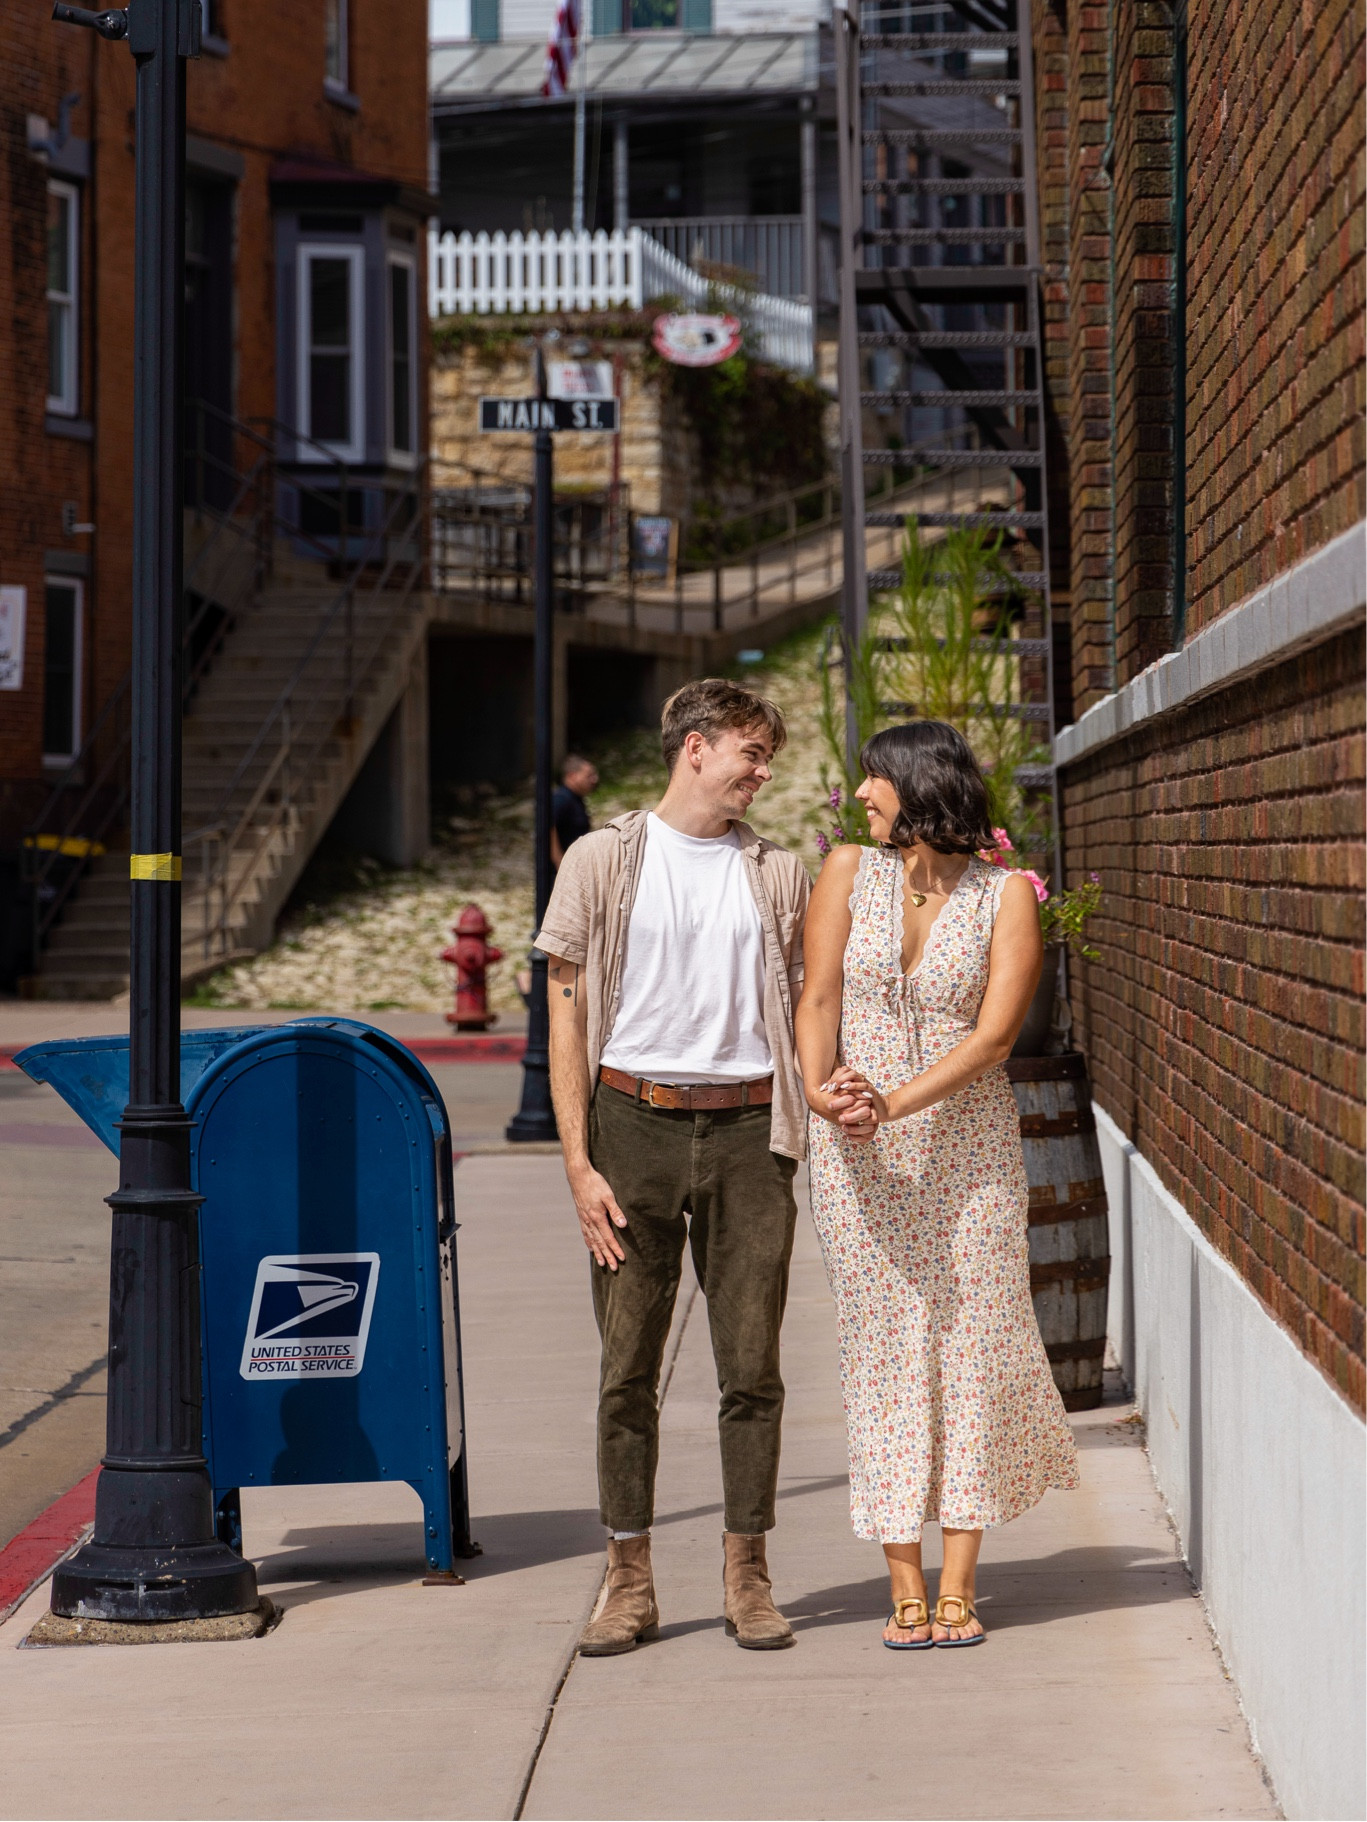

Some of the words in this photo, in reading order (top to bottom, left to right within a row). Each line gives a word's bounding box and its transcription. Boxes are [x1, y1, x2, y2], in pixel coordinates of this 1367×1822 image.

[497, 401, 555, 428] MAIN
[572, 401, 603, 428] ST.
[251, 1346, 302, 1358] UNITED
[304, 1345, 351, 1356] STATES
[248, 1361, 298, 1373] POSTAL
[301, 1359, 355, 1370] SERVICE
